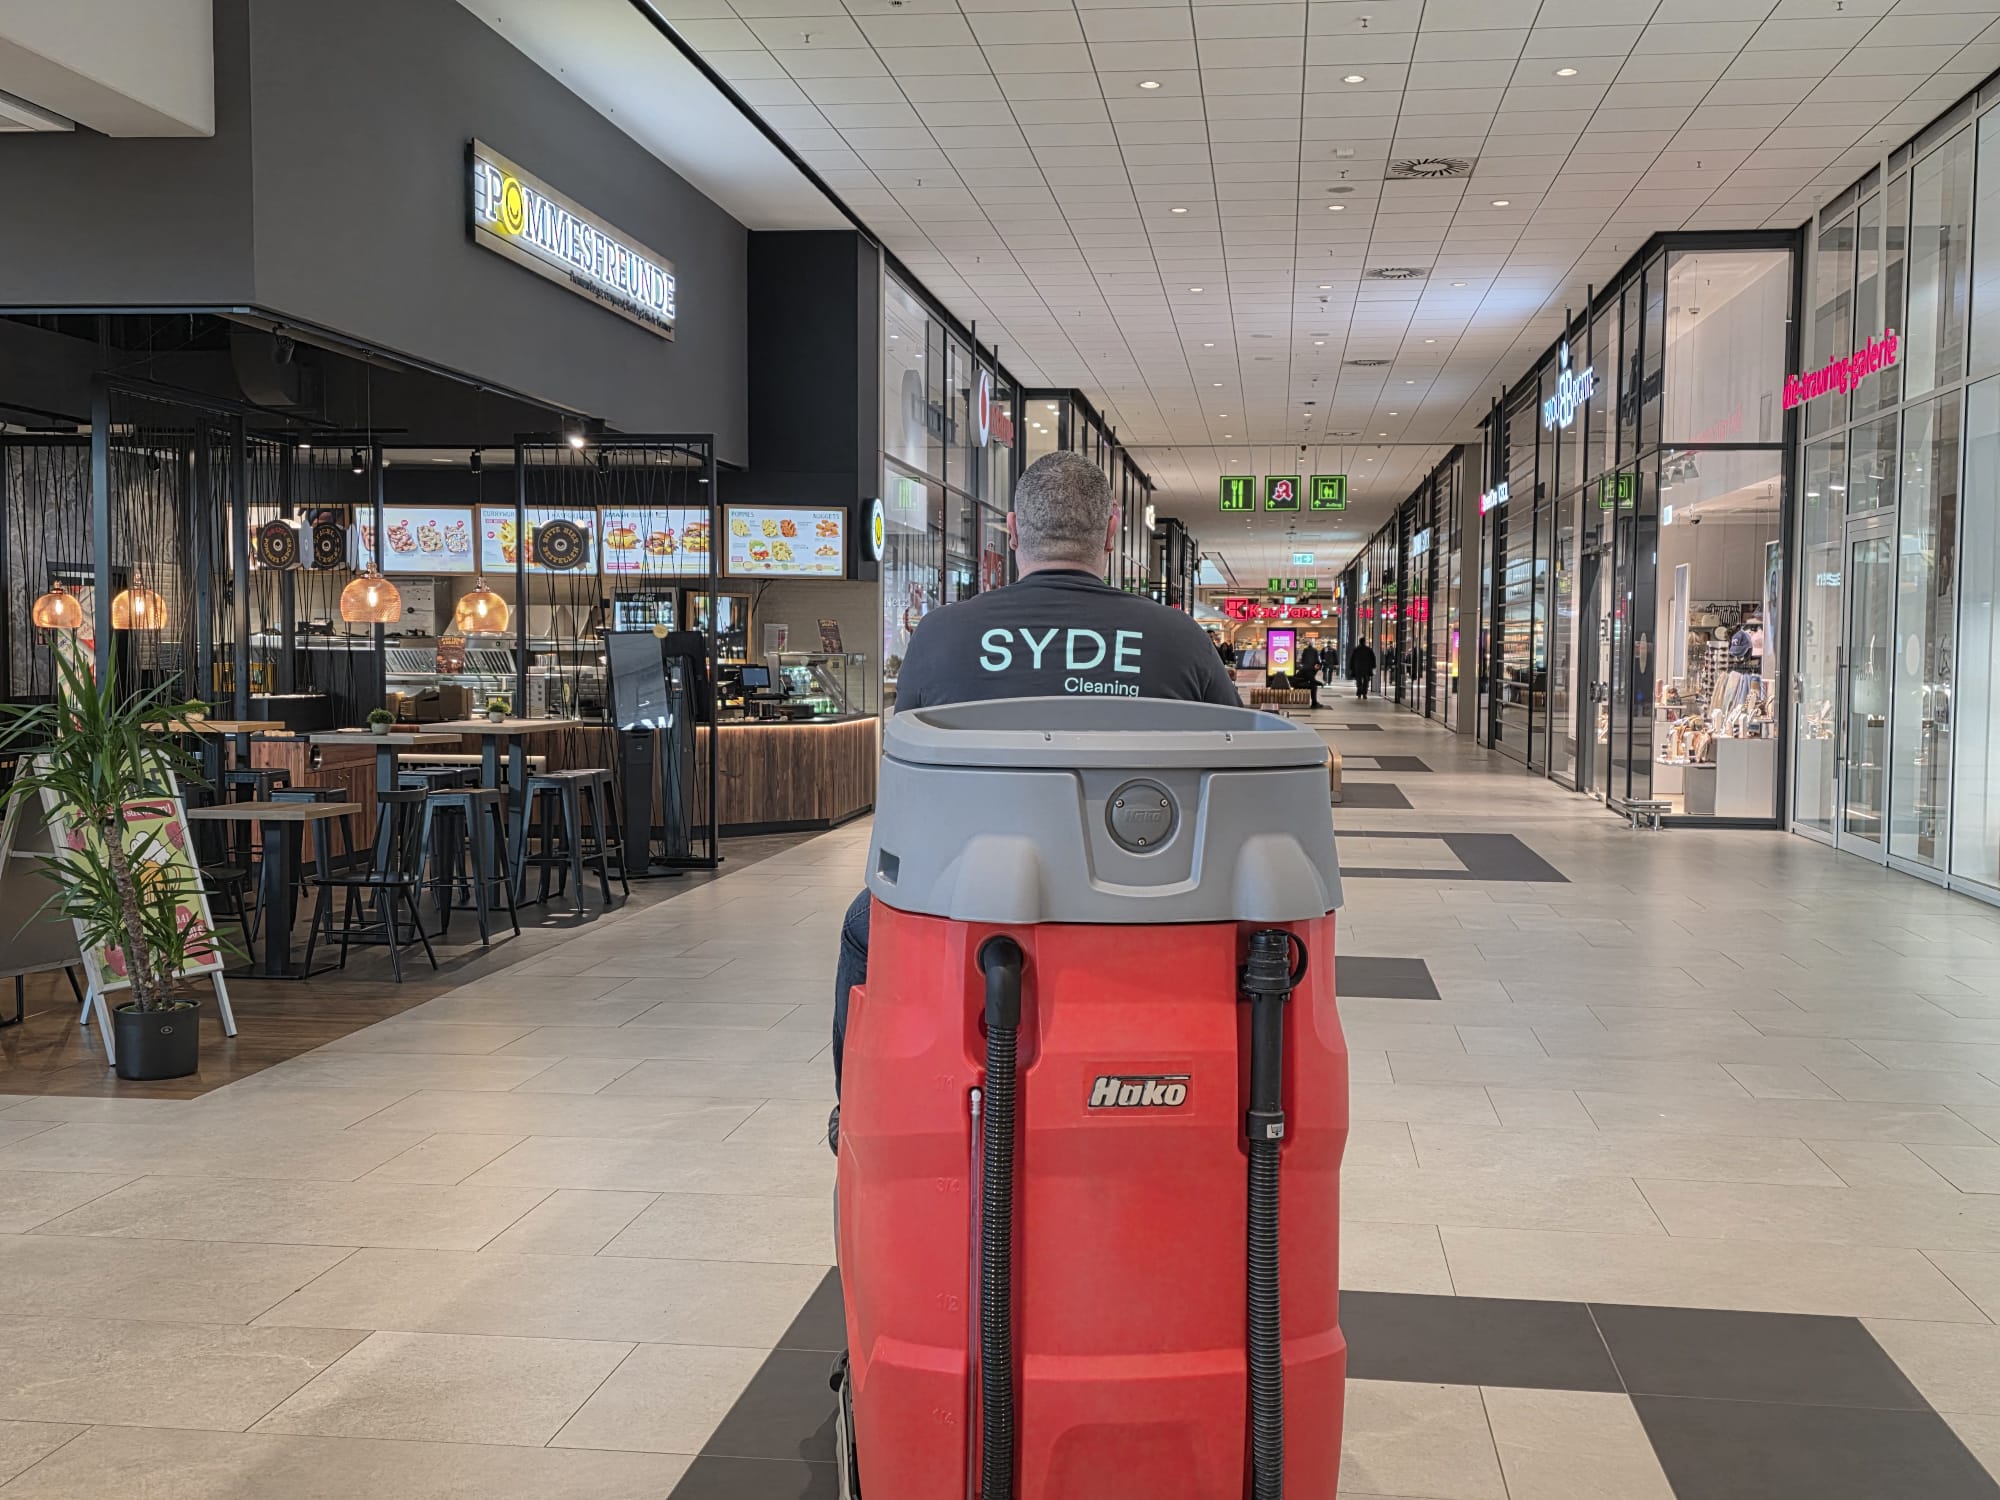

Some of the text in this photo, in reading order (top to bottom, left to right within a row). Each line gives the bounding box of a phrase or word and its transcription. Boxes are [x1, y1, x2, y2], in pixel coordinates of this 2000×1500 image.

[485, 164, 676, 319] POMMESFREUNDE
[1782, 327, 1898, 411] die-trauring-galerie
[542, 526, 580, 544] BITTE HIER
[542, 545, 580, 564] BESTELLEN
[1249, 602, 1322, 619] Kaufland
[979, 628, 1143, 674] SYDE
[1064, 677, 1140, 697] Cleaning
[1088, 1076, 1191, 1109] Hako
